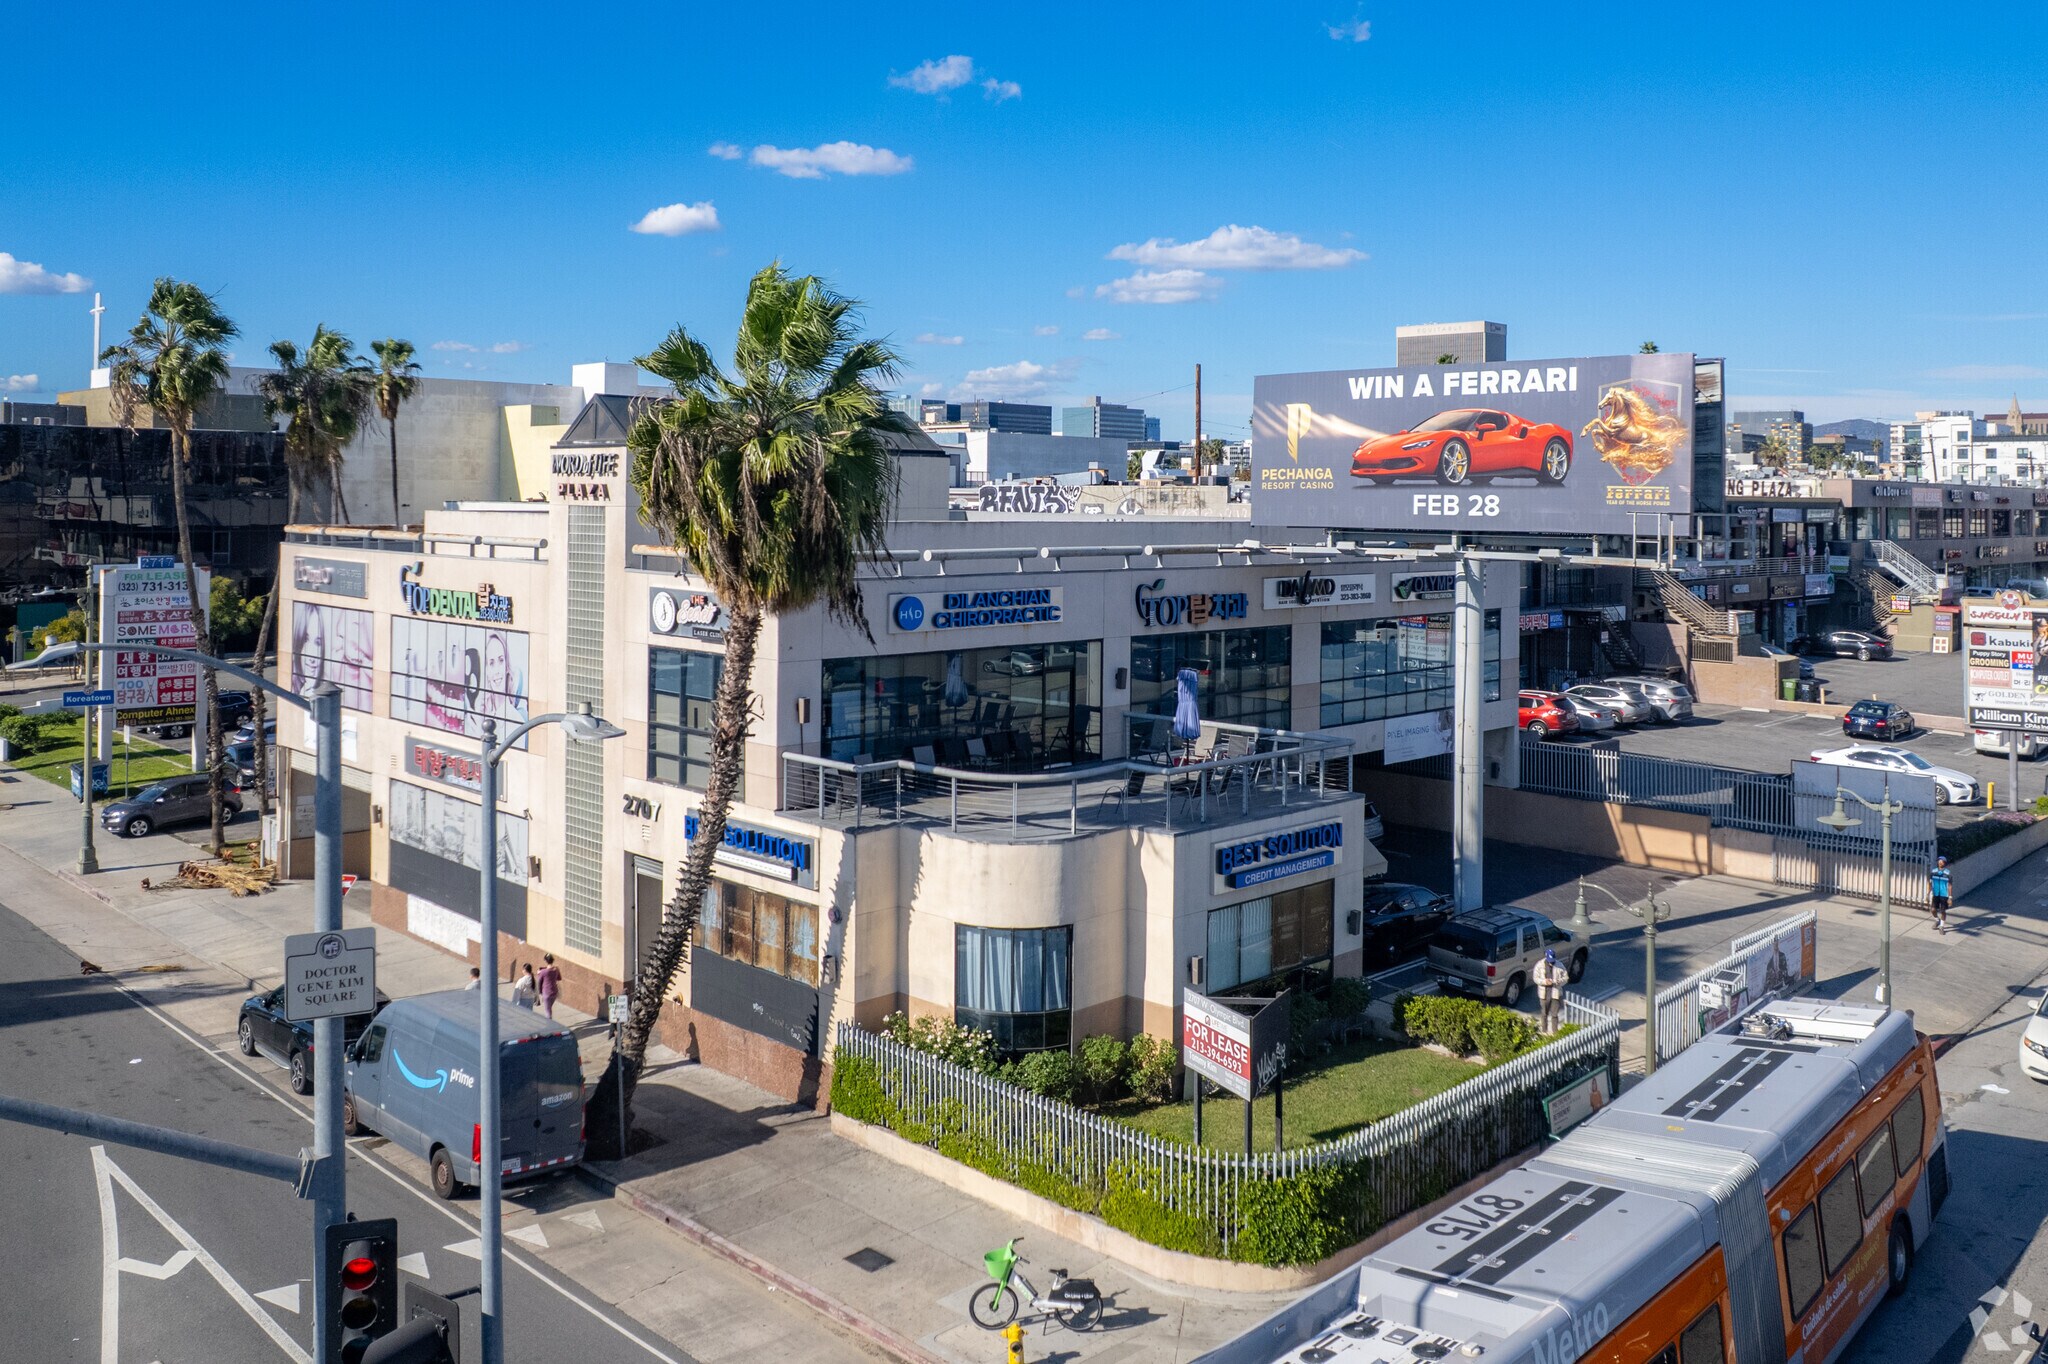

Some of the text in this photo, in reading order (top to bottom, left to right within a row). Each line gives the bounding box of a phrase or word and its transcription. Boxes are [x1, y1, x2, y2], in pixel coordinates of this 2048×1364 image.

[1348, 367, 1578, 400] WIN A FERRARI
[1262, 468, 1333, 480] PECHANGA
[558, 483, 607, 500] PLAZA
[1262, 482, 1334, 490] RESORT CASINO
[1728, 480, 1792, 497] NG PLAZA
[1412, 494, 1500, 517] FEB 28
[142, 557, 174, 568] 2717
[146, 572, 188, 580] LEASE
[1414, 576, 1456, 592] OLYMP
[118, 581, 189, 592] (323) 731-313
[430, 589, 480, 619] DENTAL
[690, 595, 705, 604] THE
[945, 589, 1051, 610] DILANCHIAN
[935, 606, 1062, 628] CHIROPRACTIC
[1144, 596, 1188, 626] TOP
[118, 625, 156, 636] SOME
[1990, 636, 2029, 647] Kabuki
[117, 665, 155, 677] 여행사
[1970, 658, 2009, 668] GROOMING
[117, 680, 144, 689] 700
[66, 695, 111, 703] Koreatown
[117, 689, 146, 704] 당구장
[1988, 690, 2026, 699] GOLDEN
[116, 709, 163, 720] Computer
[166, 706, 195, 715] Ahnex
[1975, 709, 2048, 724] William Kim
[1405, 726, 1430, 736] IMAGING
[414, 746, 445, 777] 태양
[623, 794, 662, 822] 2707
[724, 826, 806, 872] SOLUTION
[1218, 822, 1343, 876] BEST SOLUTION
[1245, 855, 1327, 885] CREDIT MANAGEMENT
[305, 964, 357, 980] DOCTOR
[297, 976, 364, 993] GENE KIM
[305, 991, 356, 1006] SQUARE
[1188, 992, 1200, 1005] 2707
[1210, 1004, 1231, 1022] Olympic
[1185, 1017, 1248, 1064] FOR LEASE
[1191, 1038, 1242, 1074] 213-394-6593
[450, 1067, 475, 1089] prime
[541, 1091, 573, 1106] amazon
[1425, 1194, 1525, 1242] 8715
[1531, 1302, 1609, 1364] Metro
